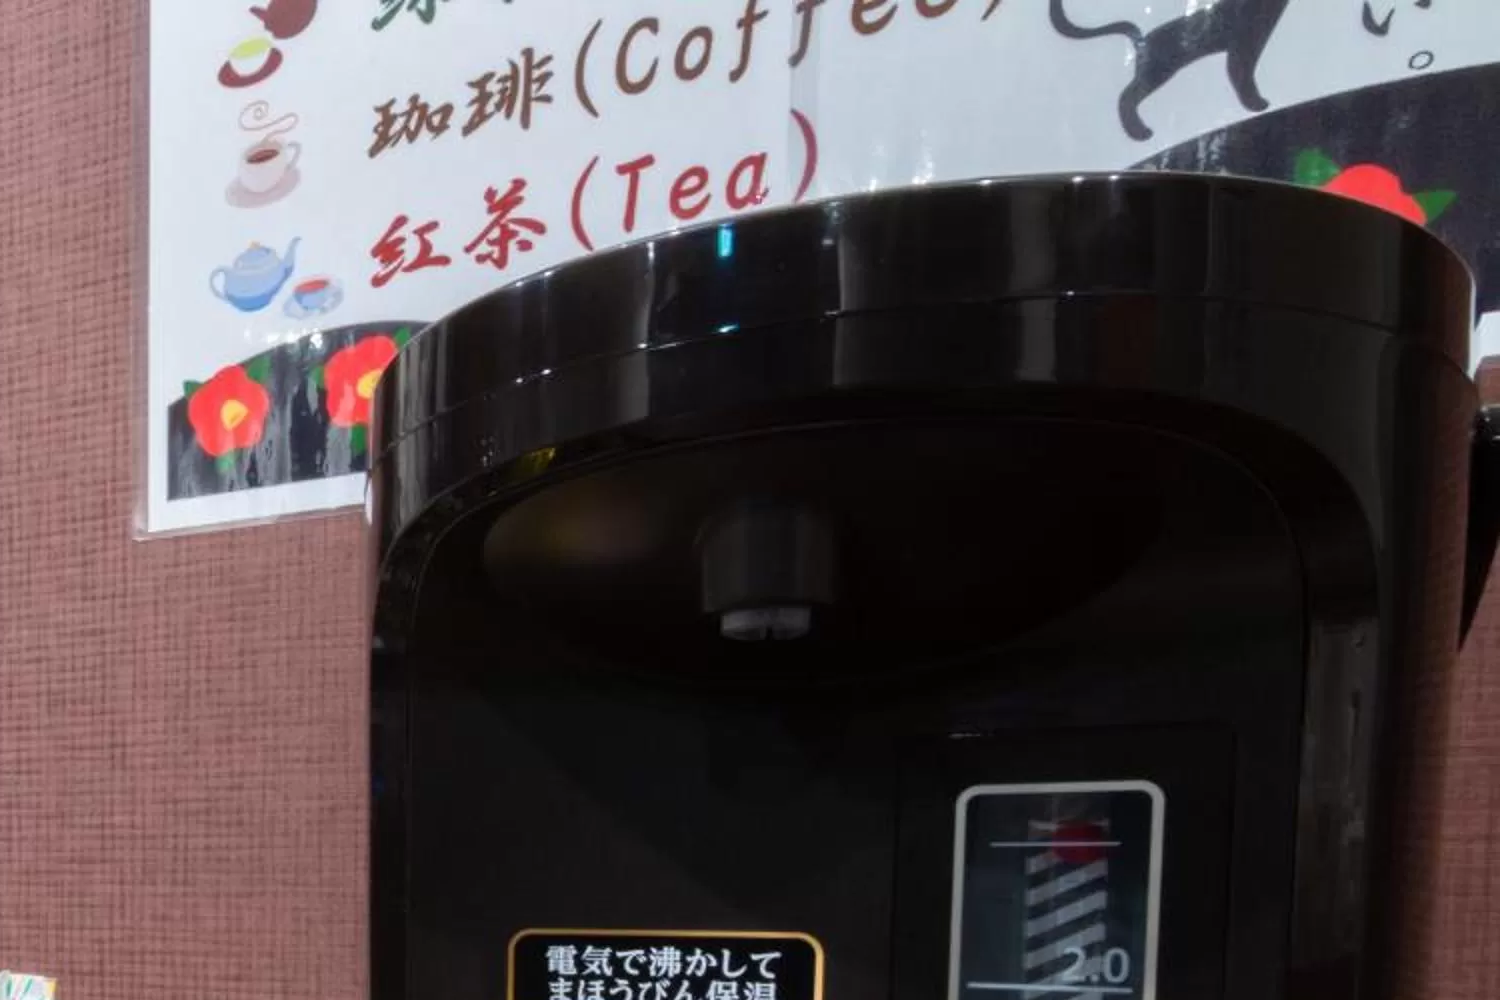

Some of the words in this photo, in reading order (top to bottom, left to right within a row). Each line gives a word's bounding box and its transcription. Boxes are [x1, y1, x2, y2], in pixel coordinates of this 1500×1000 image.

[546, 945, 782, 977] 電気で沸かして
[1061, 947, 1131, 984] 2.0
